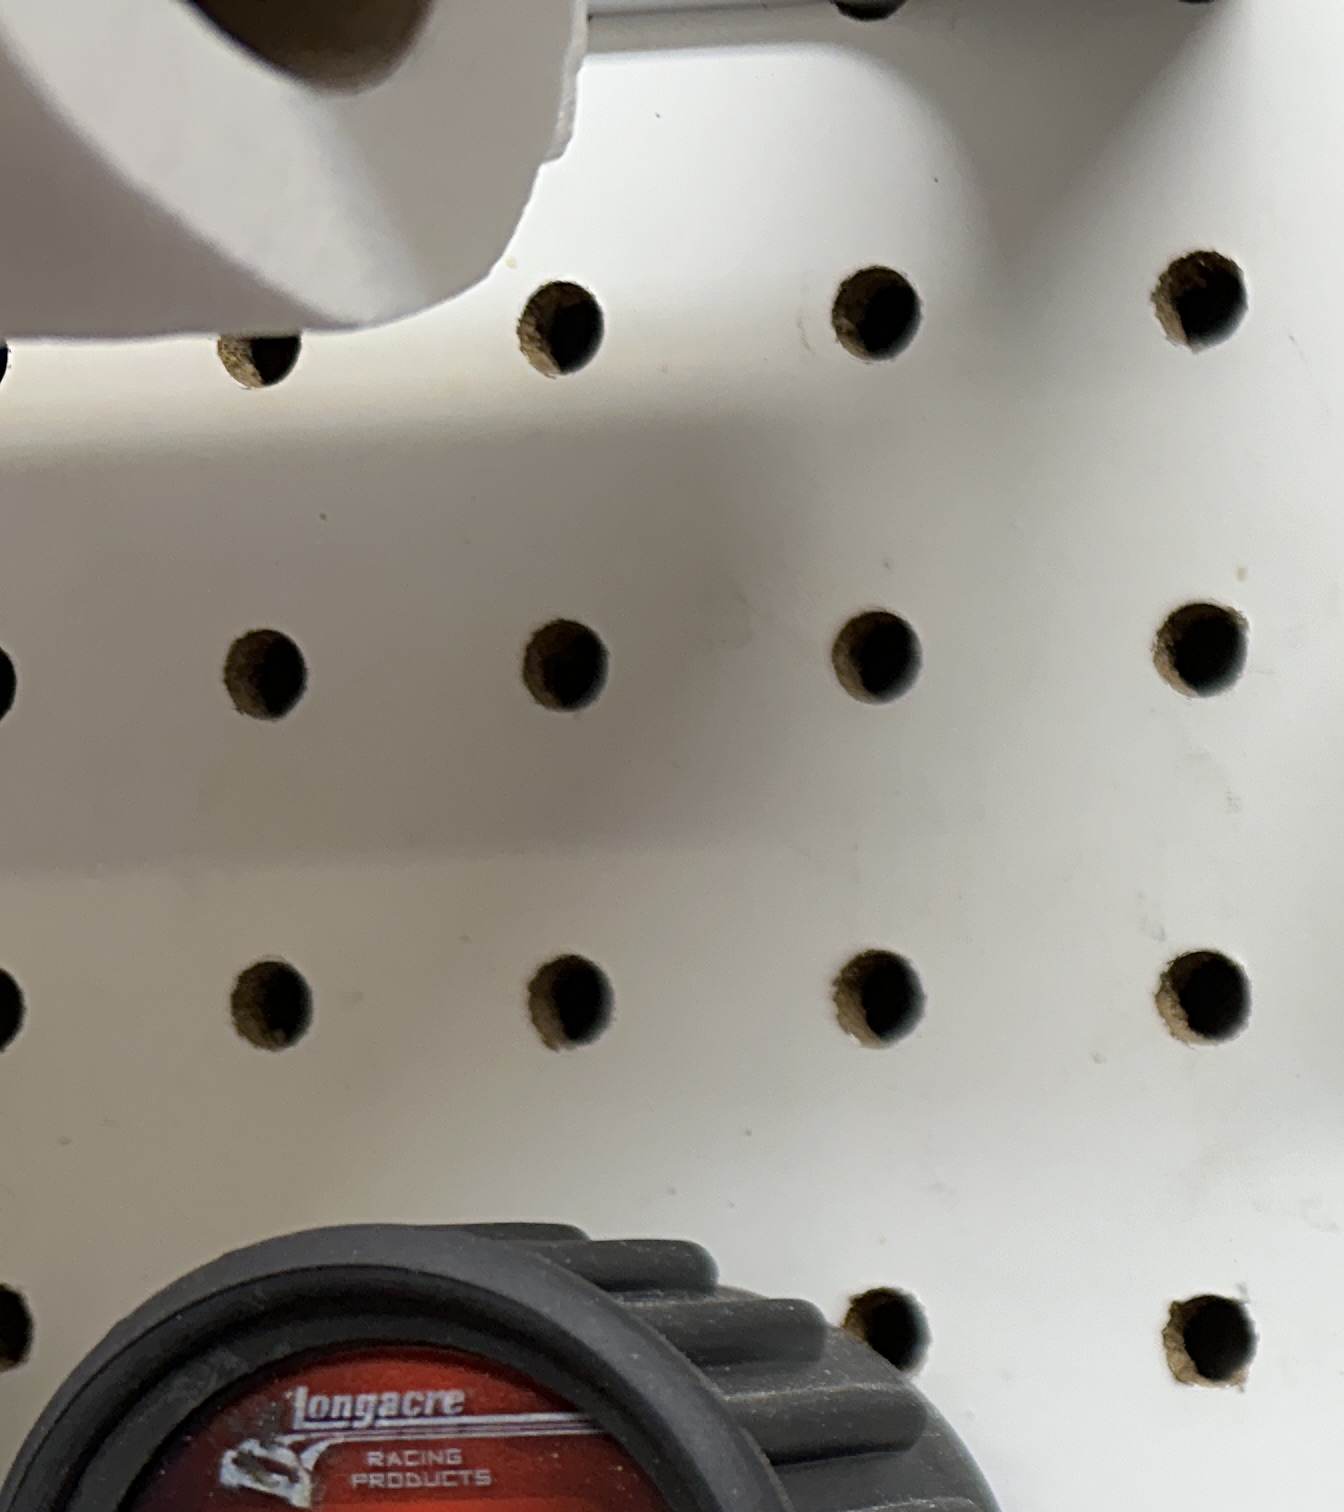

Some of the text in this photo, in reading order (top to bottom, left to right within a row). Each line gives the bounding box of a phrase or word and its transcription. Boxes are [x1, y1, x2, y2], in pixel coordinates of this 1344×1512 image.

[292, 1385, 467, 1430] Longacre
[366, 1447, 464, 1467] RACING
[350, 1469, 493, 1489] PRODUCTS
